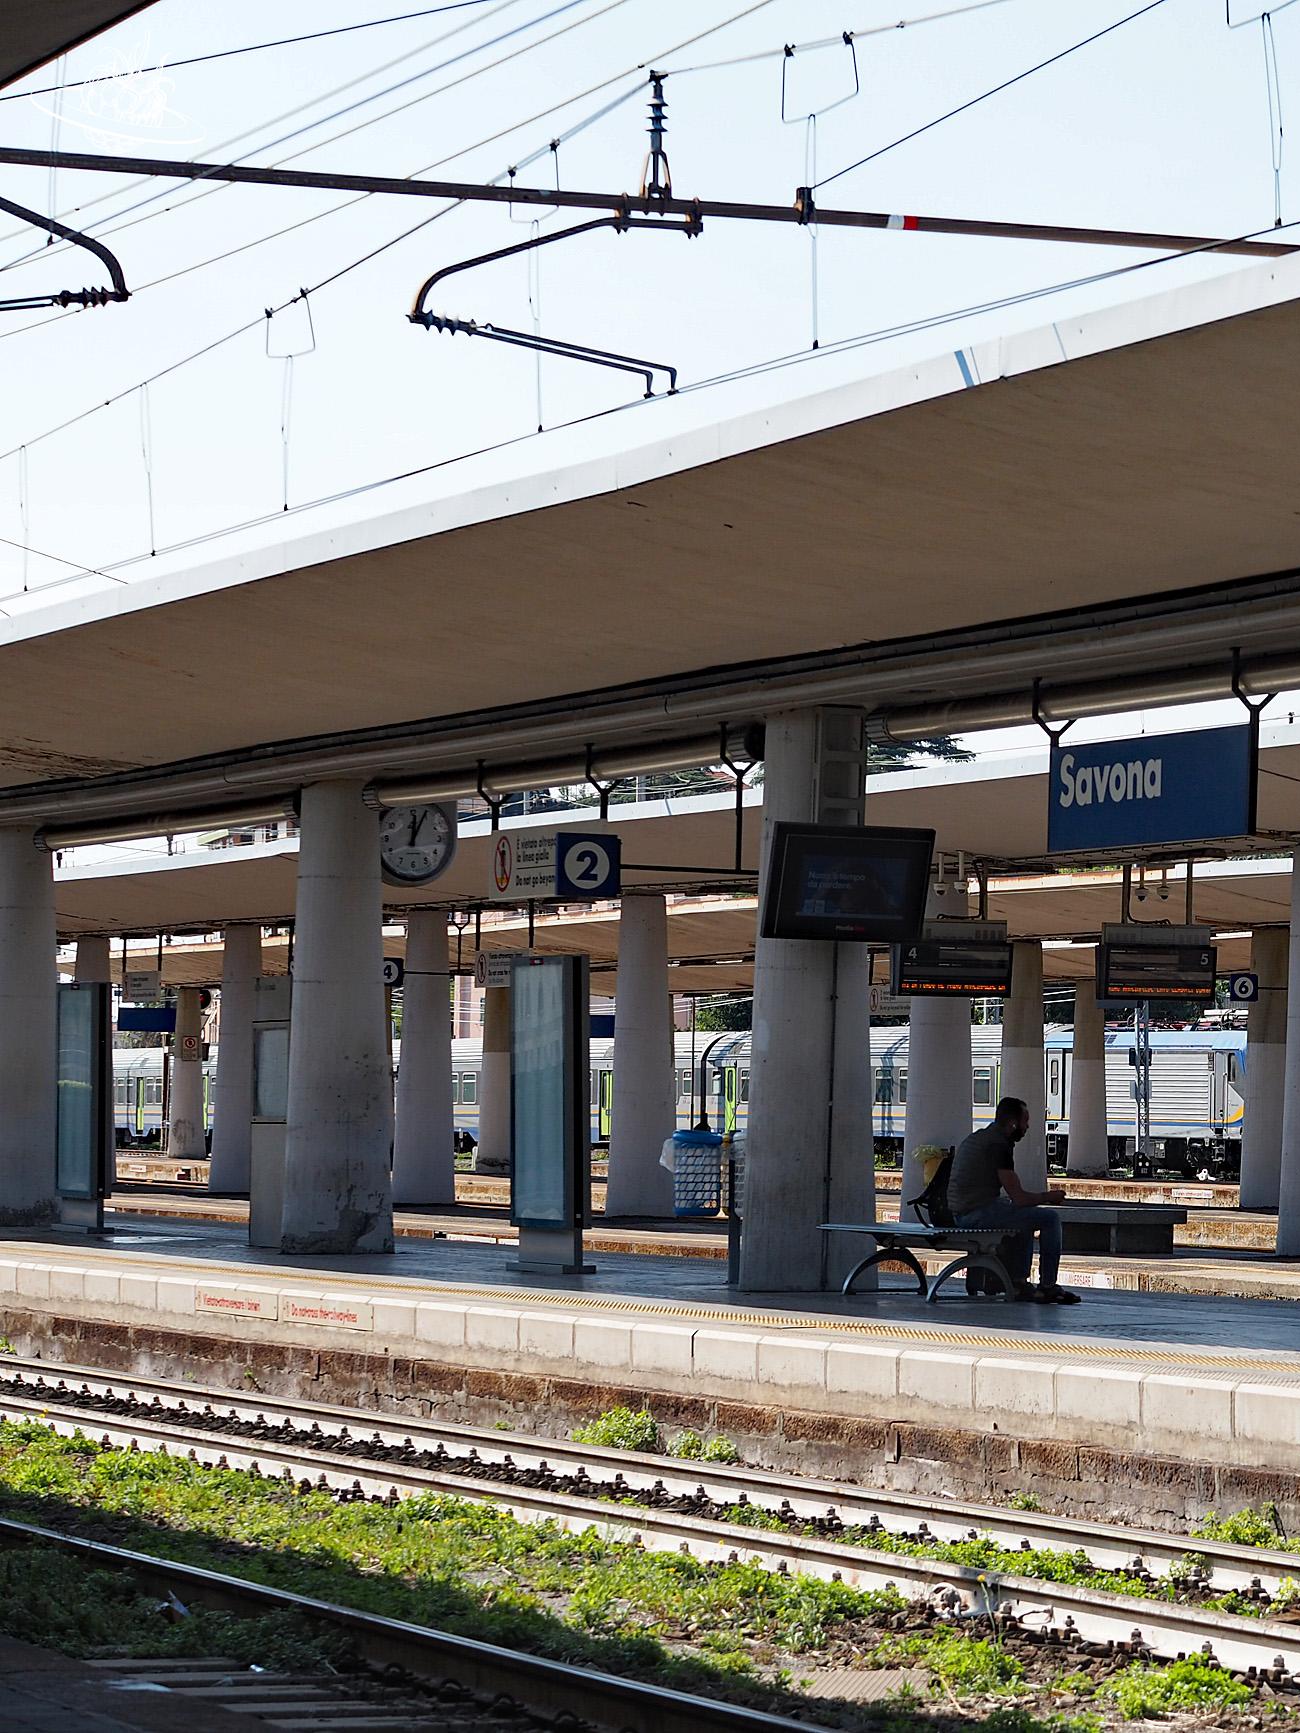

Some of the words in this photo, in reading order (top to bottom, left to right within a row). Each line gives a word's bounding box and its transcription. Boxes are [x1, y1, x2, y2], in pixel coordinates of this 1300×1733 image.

[1059, 753, 1162, 808] Savona
[575, 849, 599, 882] 2
[539, 871, 555, 887] beyon
[908, 946, 918, 960] 4
[1199, 952, 1209, 966] 5
[383, 964, 393, 980] 4
[1238, 979, 1250, 995] 6
